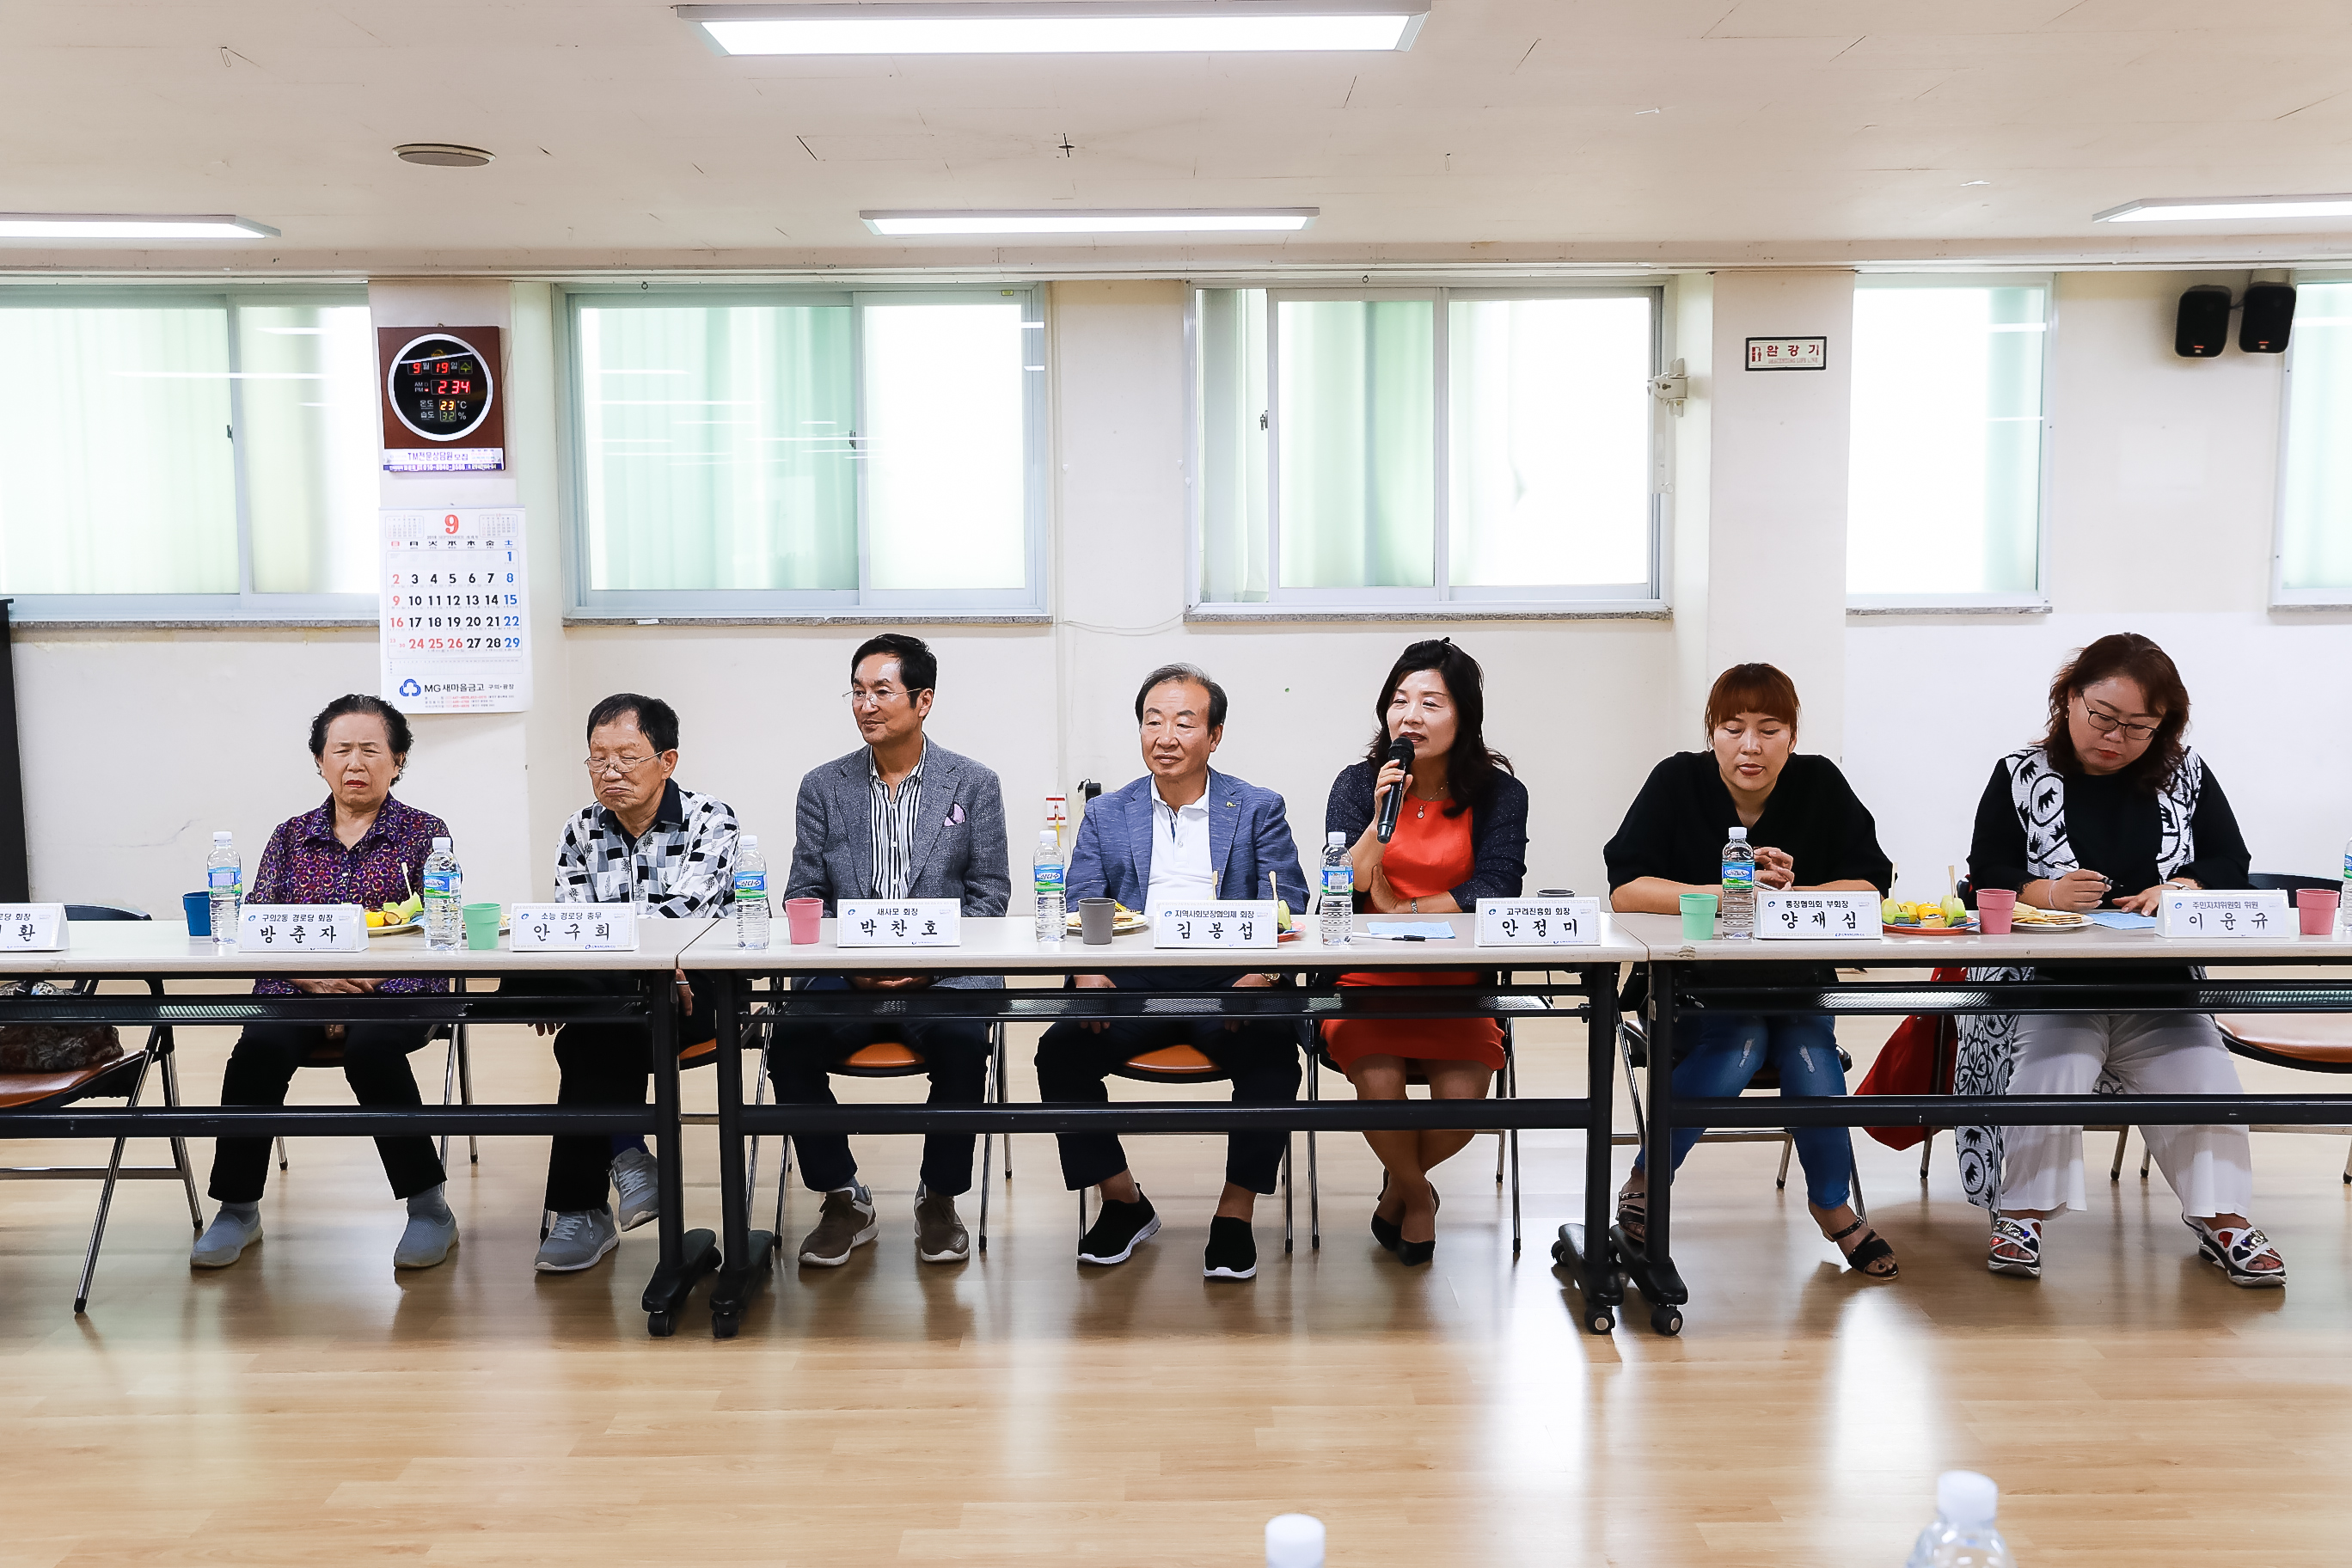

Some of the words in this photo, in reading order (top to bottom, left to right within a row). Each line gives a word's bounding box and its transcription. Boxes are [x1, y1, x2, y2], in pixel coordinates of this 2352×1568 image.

[436, 363, 448, 373] 19
[440, 401, 454, 410] 23
[445, 514, 459, 534] 9
[507, 551, 512, 562] 1
[393, 574, 400, 584] 2
[412, 574, 418, 584] 3
[430, 574, 437, 584] 4
[449, 574, 456, 584] 5
[469, 573, 476, 583] 6
[487, 573, 494, 583] 7
[507, 573, 513, 583] 8
[393, 596, 400, 606] 9
[409, 596, 422, 606] 10
[429, 596, 441, 605] 11
[447, 595, 460, 605] 12
[466, 595, 479, 605] 13
[486, 595, 498, 605] 14
[504, 595, 517, 605] 15
[390, 617, 404, 627] 16
[409, 617, 422, 627] 17
[429, 617, 442, 627] 18
[448, 617, 461, 627] 19
[466, 617, 481, 627] 20
[486, 616, 499, 626] 21
[504, 616, 519, 626] 22
[409, 639, 424, 649] 24
[429, 639, 443, 649] 25
[447, 638, 463, 648] 26
[467, 638, 481, 648] 27
[486, 638, 501, 648] 28
[505, 638, 520, 648] 29
[425, 684, 441, 692] MG
[443, 683, 484, 692] 새마을금고
